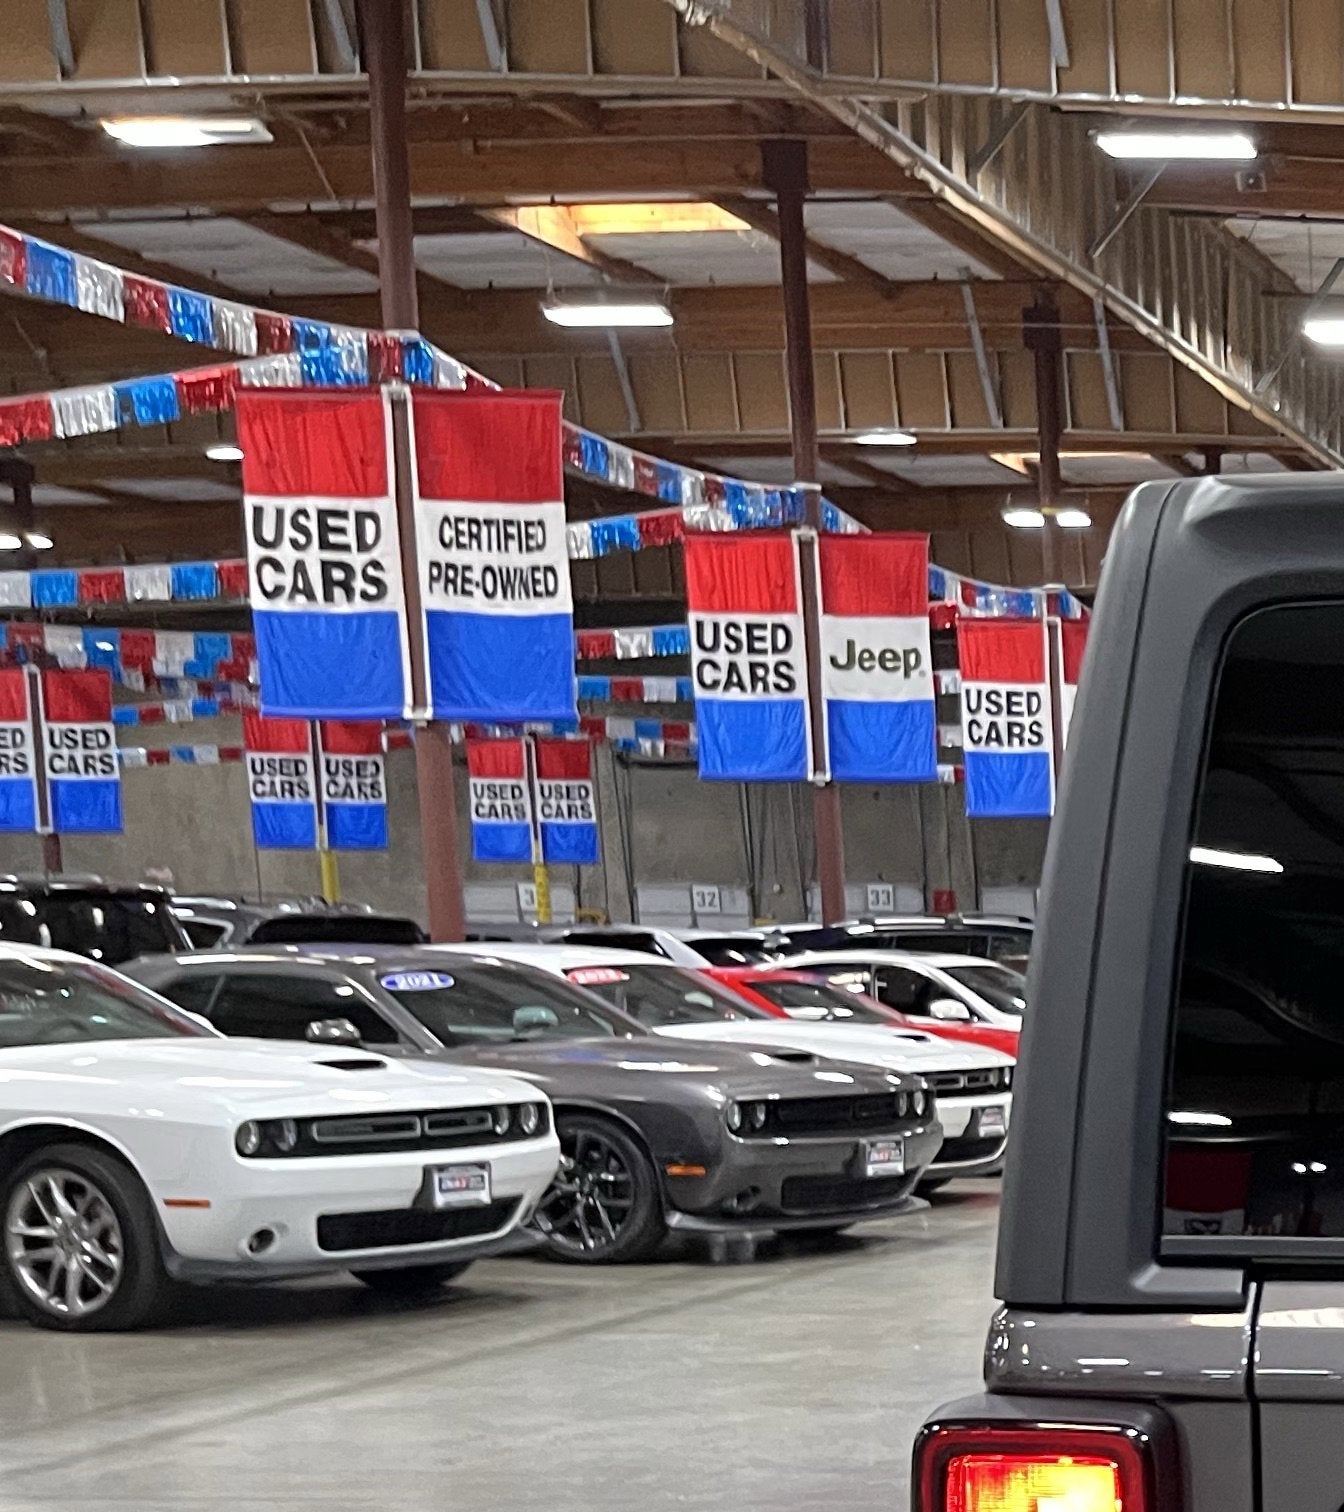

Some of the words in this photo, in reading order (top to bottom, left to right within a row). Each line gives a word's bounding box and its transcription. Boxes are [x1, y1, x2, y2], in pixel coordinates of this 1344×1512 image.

[252, 505, 382, 553] USED
[438, 515, 547, 554] CERTIFIED
[255, 556, 388, 605] CARS
[428, 559, 559, 601] PRE-OWNED
[695, 620, 793, 655] USED
[829, 639, 922, 679] Jeep
[696, 659, 797, 695] CARS
[965, 689, 1043, 717] USED
[0, 727, 25, 749] ED
[48, 727, 111, 750] USED
[967, 720, 1045, 747] CARS
[48, 753, 115, 775] CARS
[250, 757, 308, 777] USED
[324, 757, 380, 779] USED
[252, 779, 310, 799] CARS
[326, 779, 383, 801] CARS
[472, 783, 524, 801] USED
[540, 783, 590, 801] USED
[475, 802, 527, 820] CARS
[541, 802, 593, 820] CARS
[695, 890, 718, 908] 32
[870, 889, 891, 907] 33
